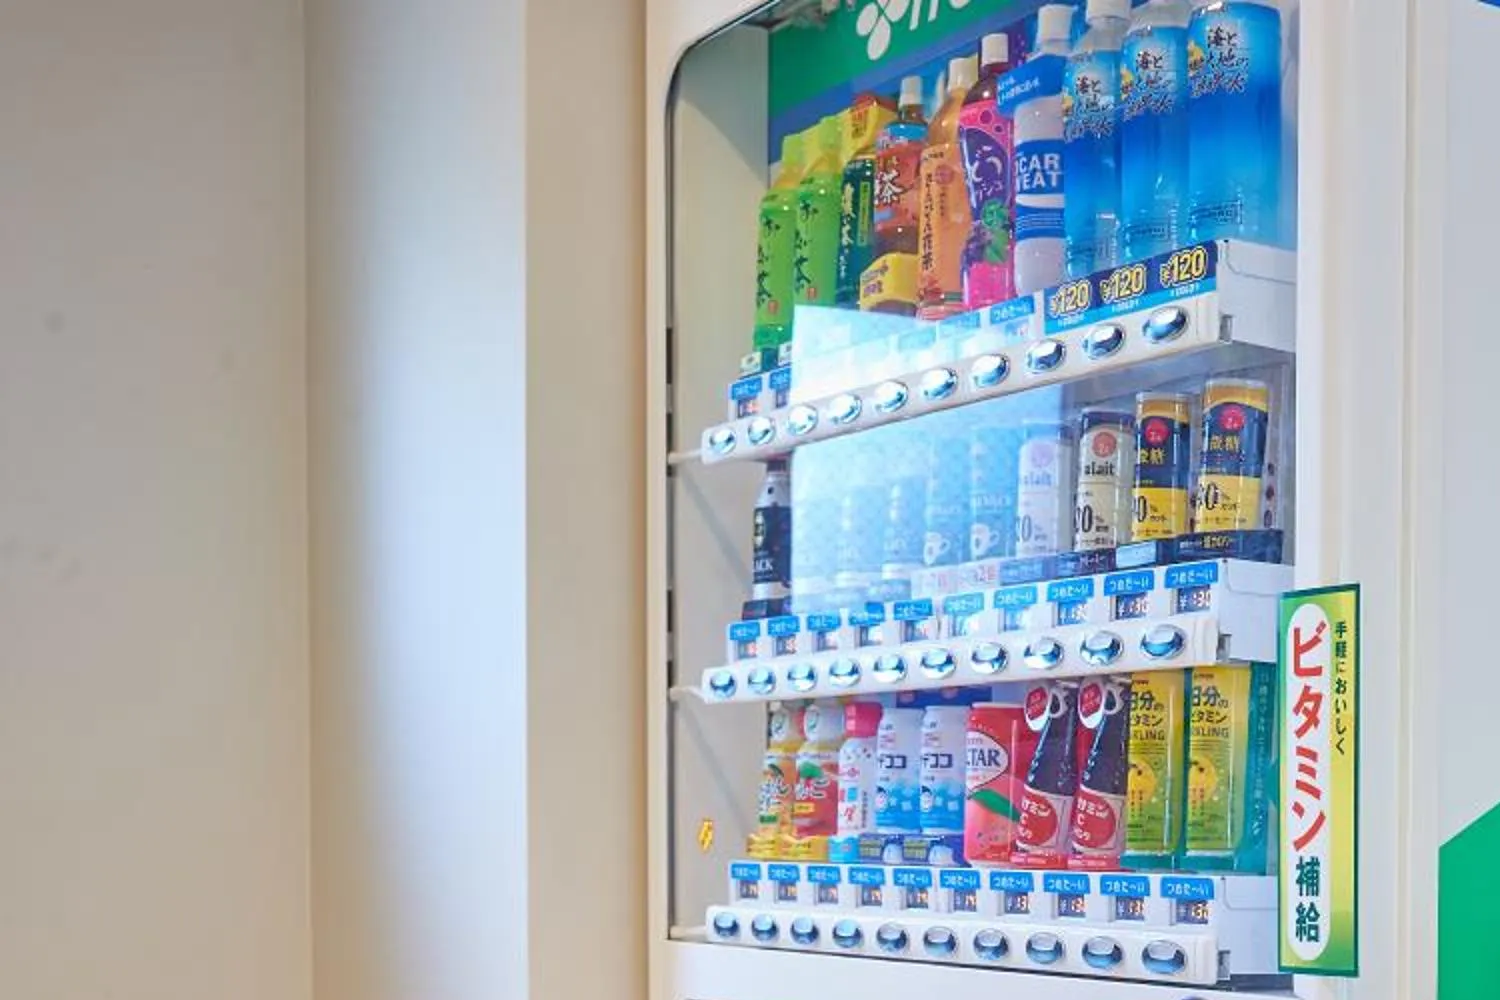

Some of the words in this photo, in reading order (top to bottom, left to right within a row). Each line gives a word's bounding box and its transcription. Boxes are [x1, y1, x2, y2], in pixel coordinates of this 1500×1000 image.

[1291, 620, 1328, 944] ビタミン補給
[1335, 621, 1348, 755] 手軽においしく
